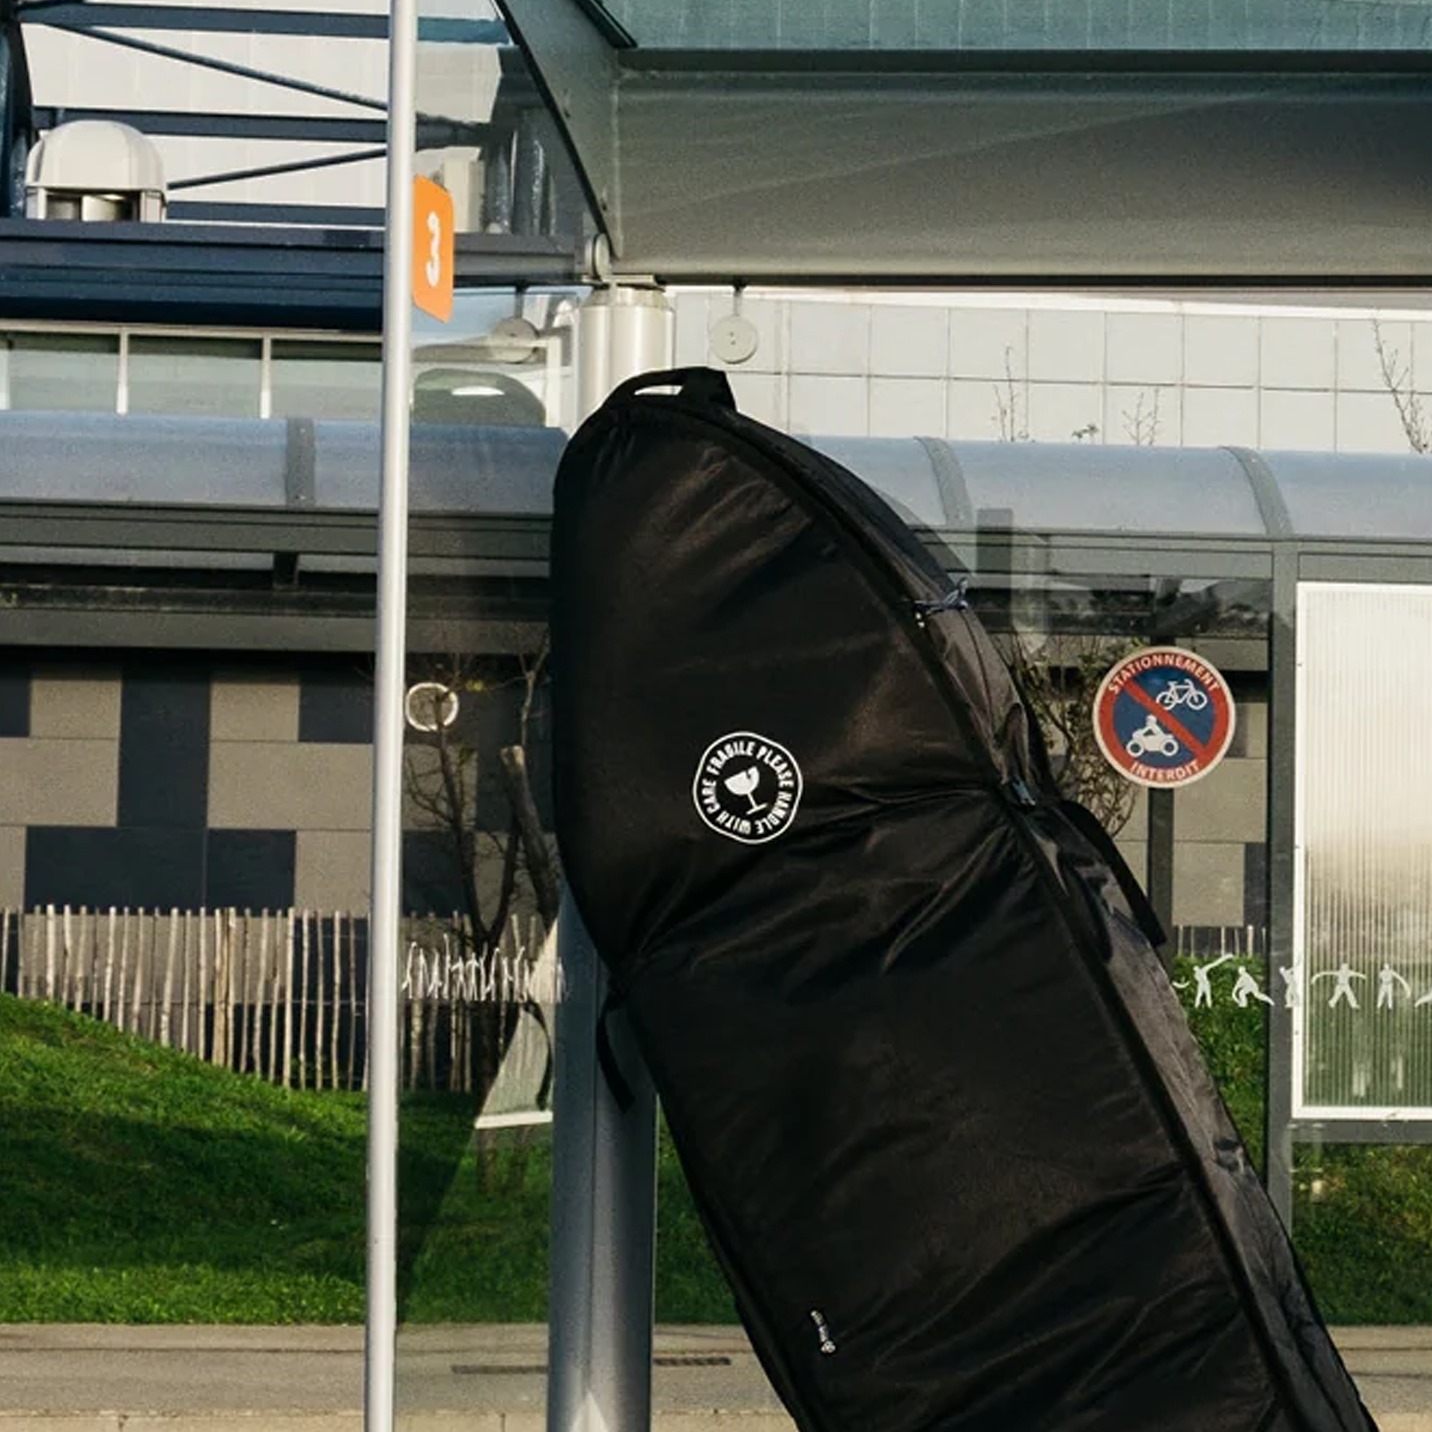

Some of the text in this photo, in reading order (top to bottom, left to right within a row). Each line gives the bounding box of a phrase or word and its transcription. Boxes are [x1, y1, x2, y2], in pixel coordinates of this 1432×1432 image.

[425, 211, 441, 288] 3
[1108, 653, 1220, 695] STATIONNEMENT
[701, 740, 795, 835] FRAGILE PLEASE HANDLE WITH CARE
[1130, 759, 1200, 782] INTERDIT
